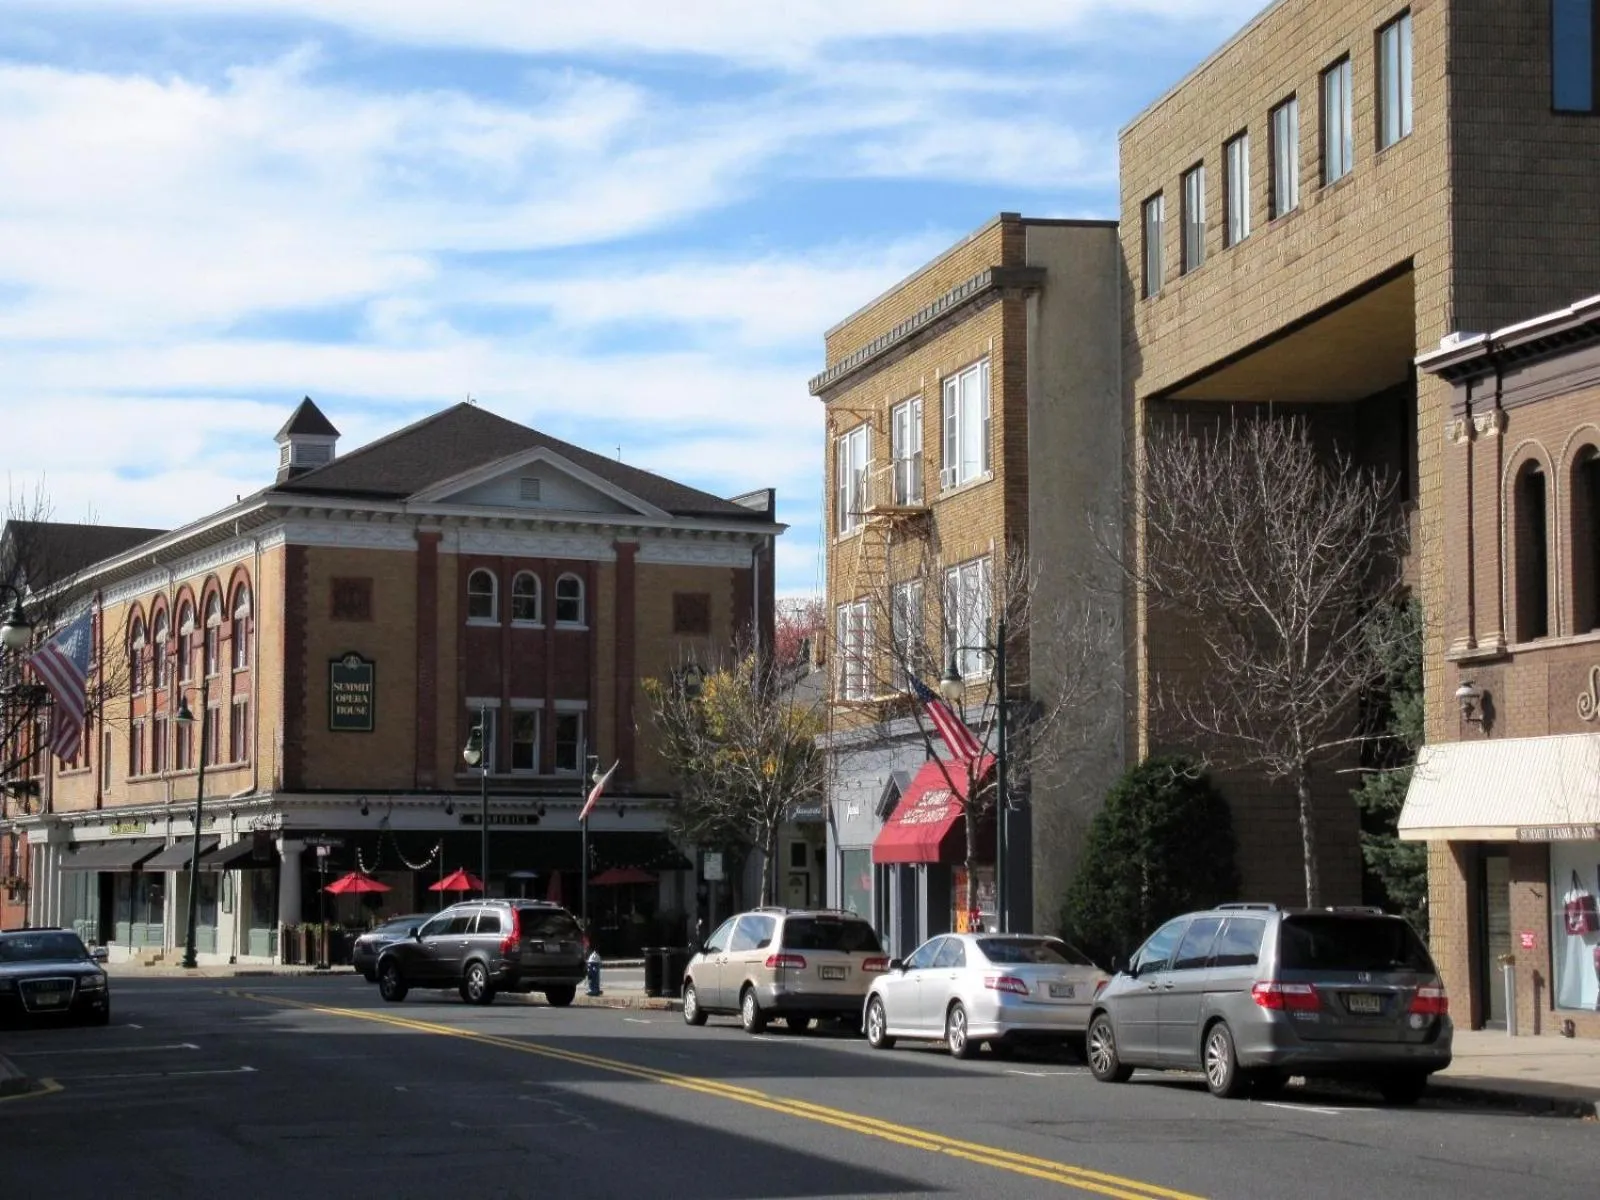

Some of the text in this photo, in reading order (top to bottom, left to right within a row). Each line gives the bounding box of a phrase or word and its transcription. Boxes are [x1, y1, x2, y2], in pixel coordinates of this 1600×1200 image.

[333, 682, 370, 692] SUMMIT
[335, 694, 368, 703] OPERA
[336, 705, 368, 715] HOUSE
[1520, 827, 1547, 840] SUMMIT
